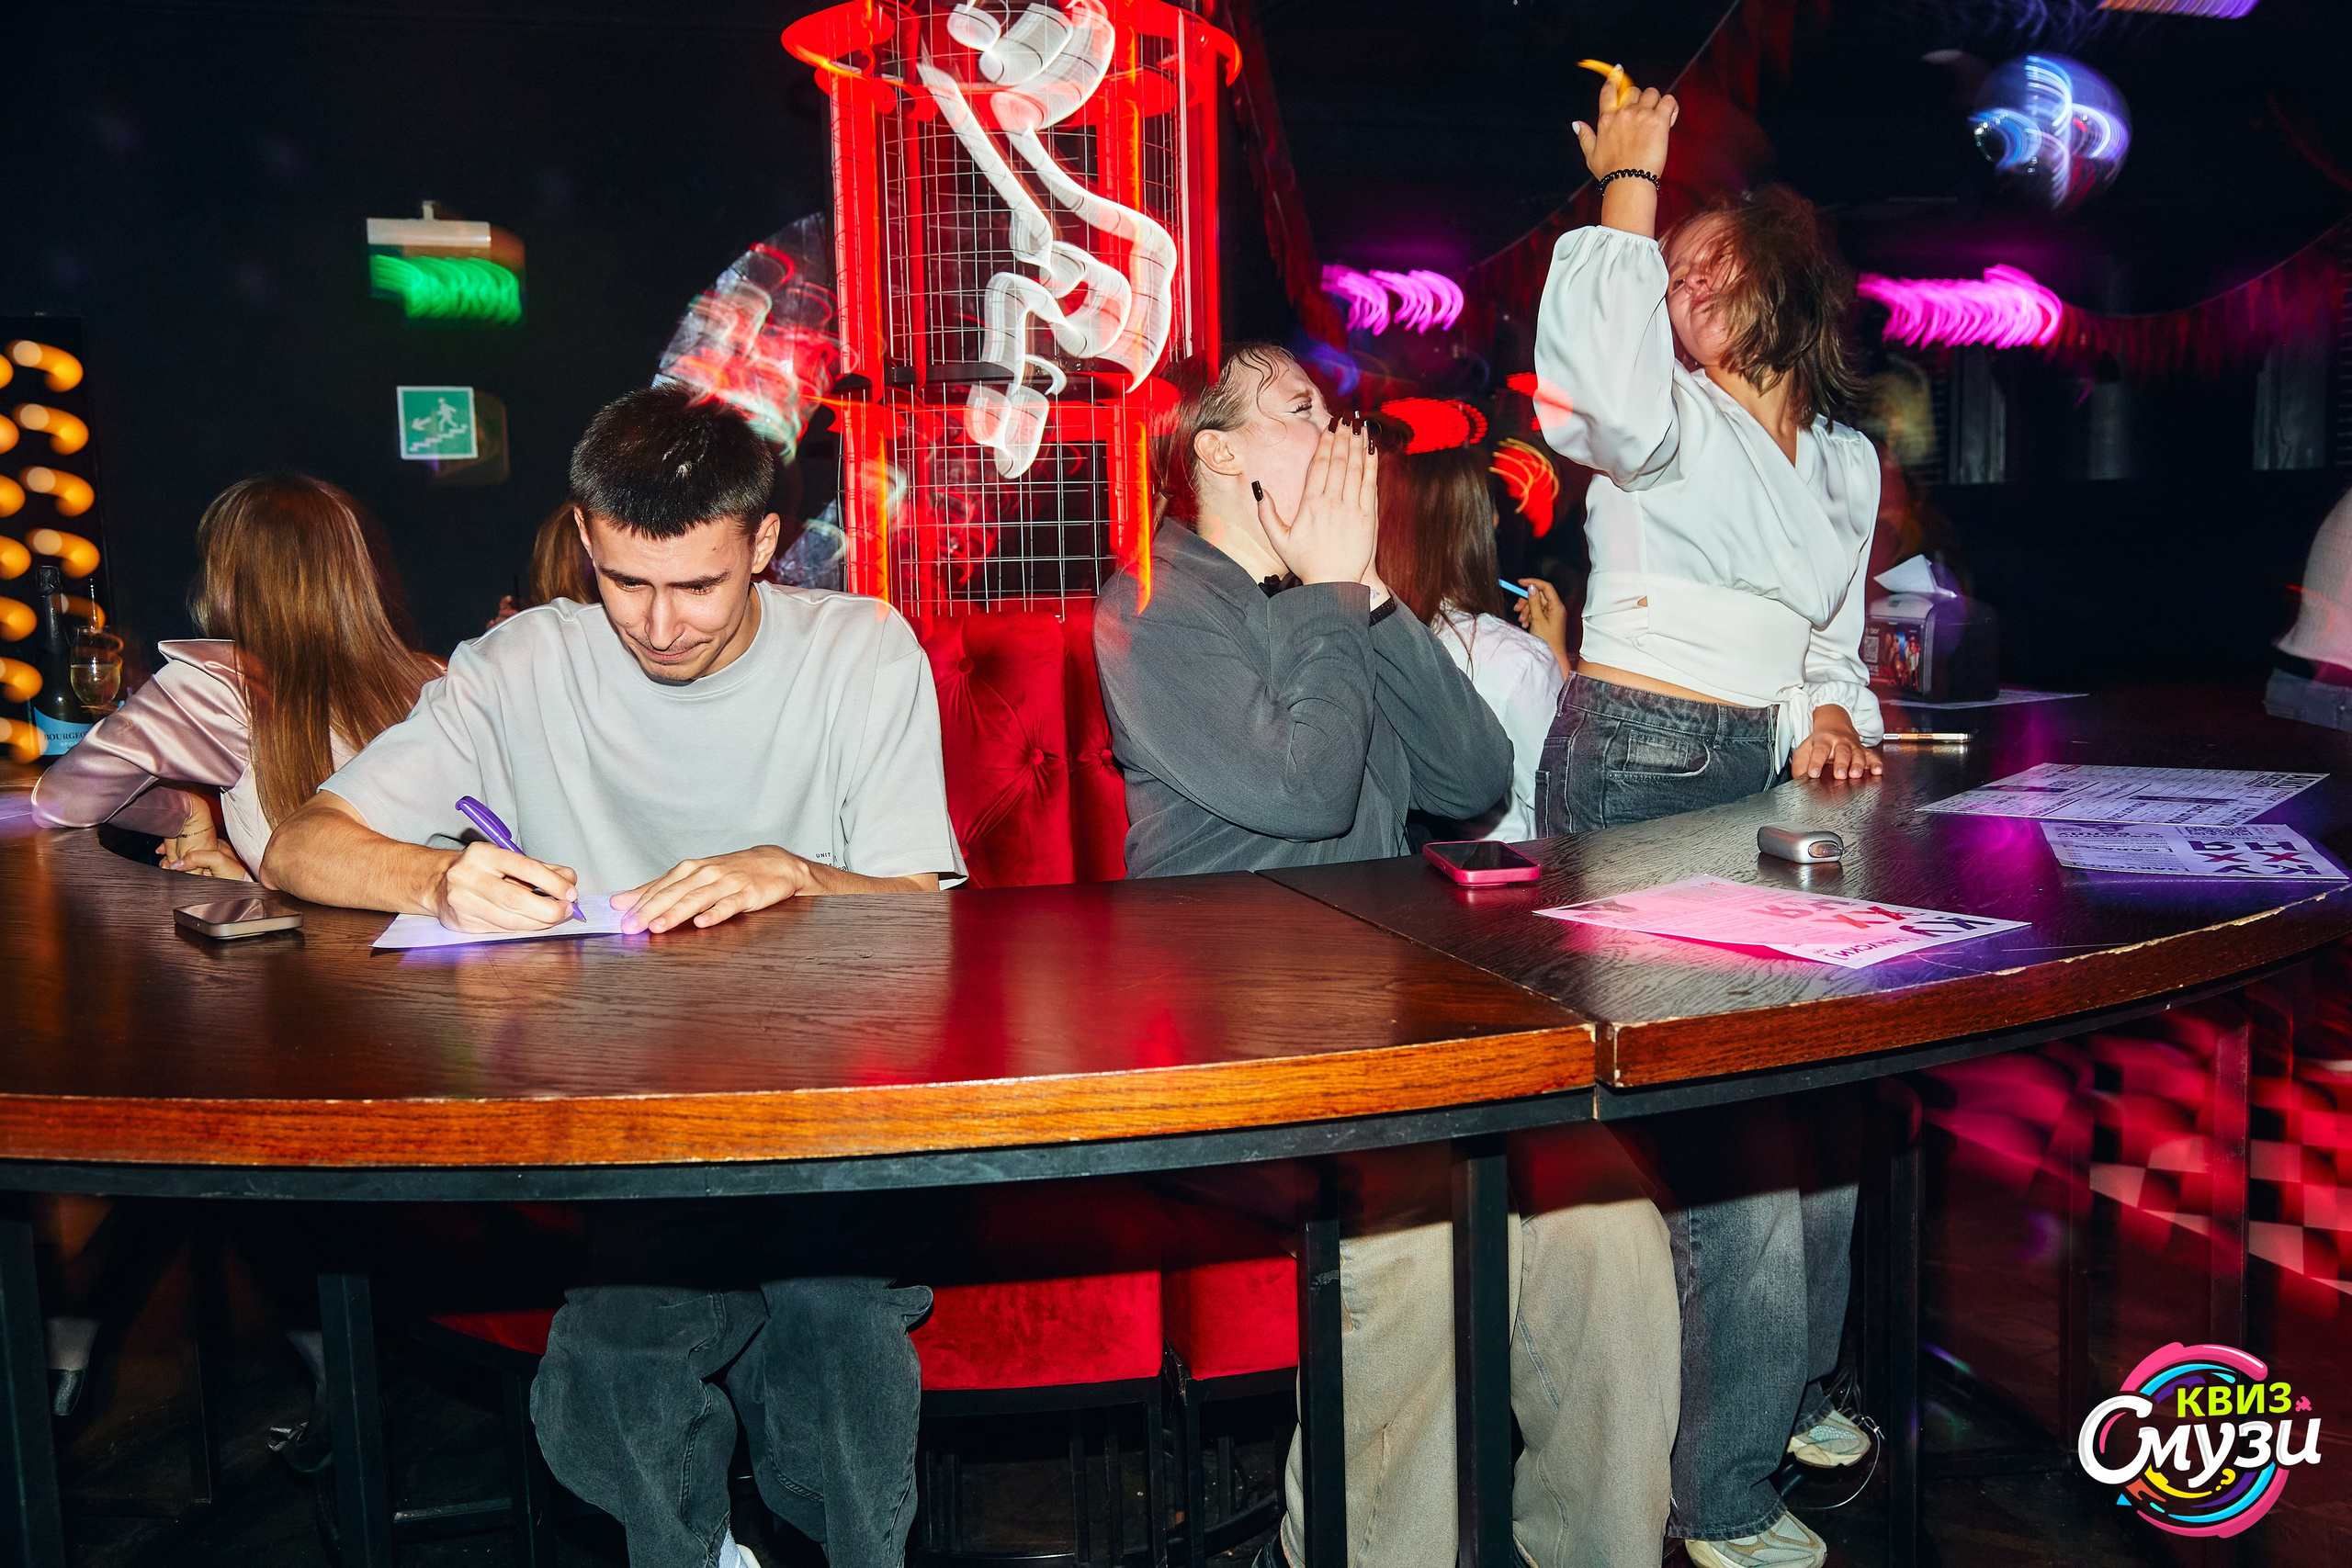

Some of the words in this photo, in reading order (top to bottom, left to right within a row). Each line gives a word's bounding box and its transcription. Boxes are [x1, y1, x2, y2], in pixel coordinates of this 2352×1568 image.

[44, 731, 88, 740] BOURGEO
[2188, 840, 2298, 852] НЯ
[2196, 852, 2311, 863] ХХ
[2212, 864, 2322, 875] КУ
[1811, 906, 1907, 930] ХХ
[1899, 916, 1996, 938] КУ
